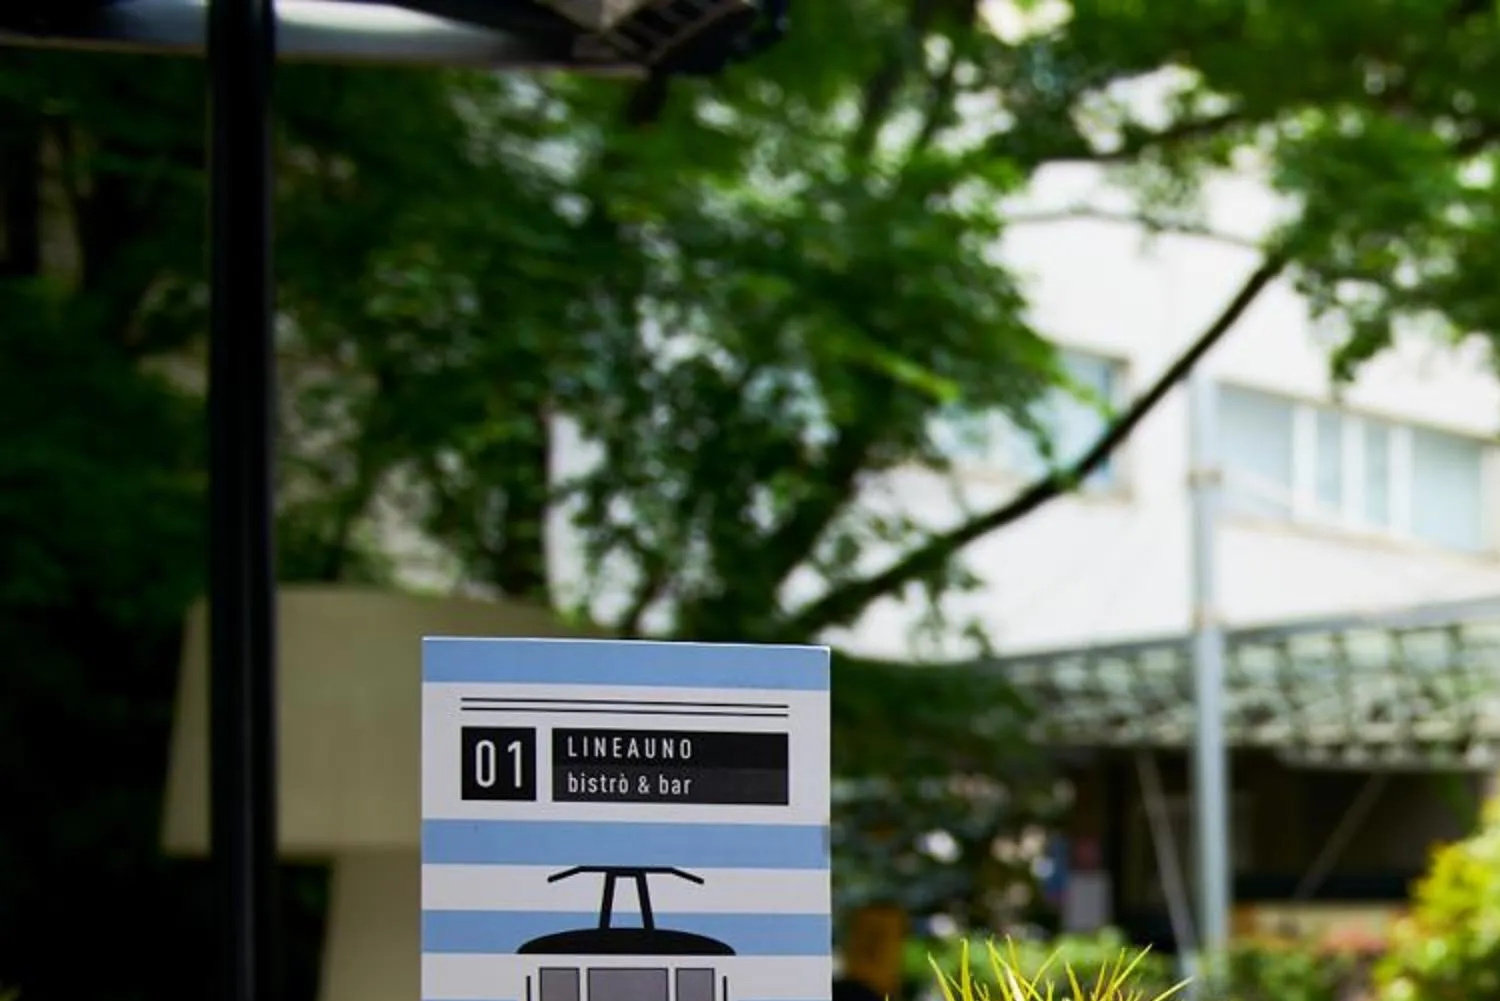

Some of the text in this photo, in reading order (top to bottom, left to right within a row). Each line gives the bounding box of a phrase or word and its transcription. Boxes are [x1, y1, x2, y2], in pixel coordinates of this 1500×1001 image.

[567, 736, 692, 760] LINEAUNO
[475, 739, 523, 789] 01
[567, 771, 692, 795] bistrò & bar
